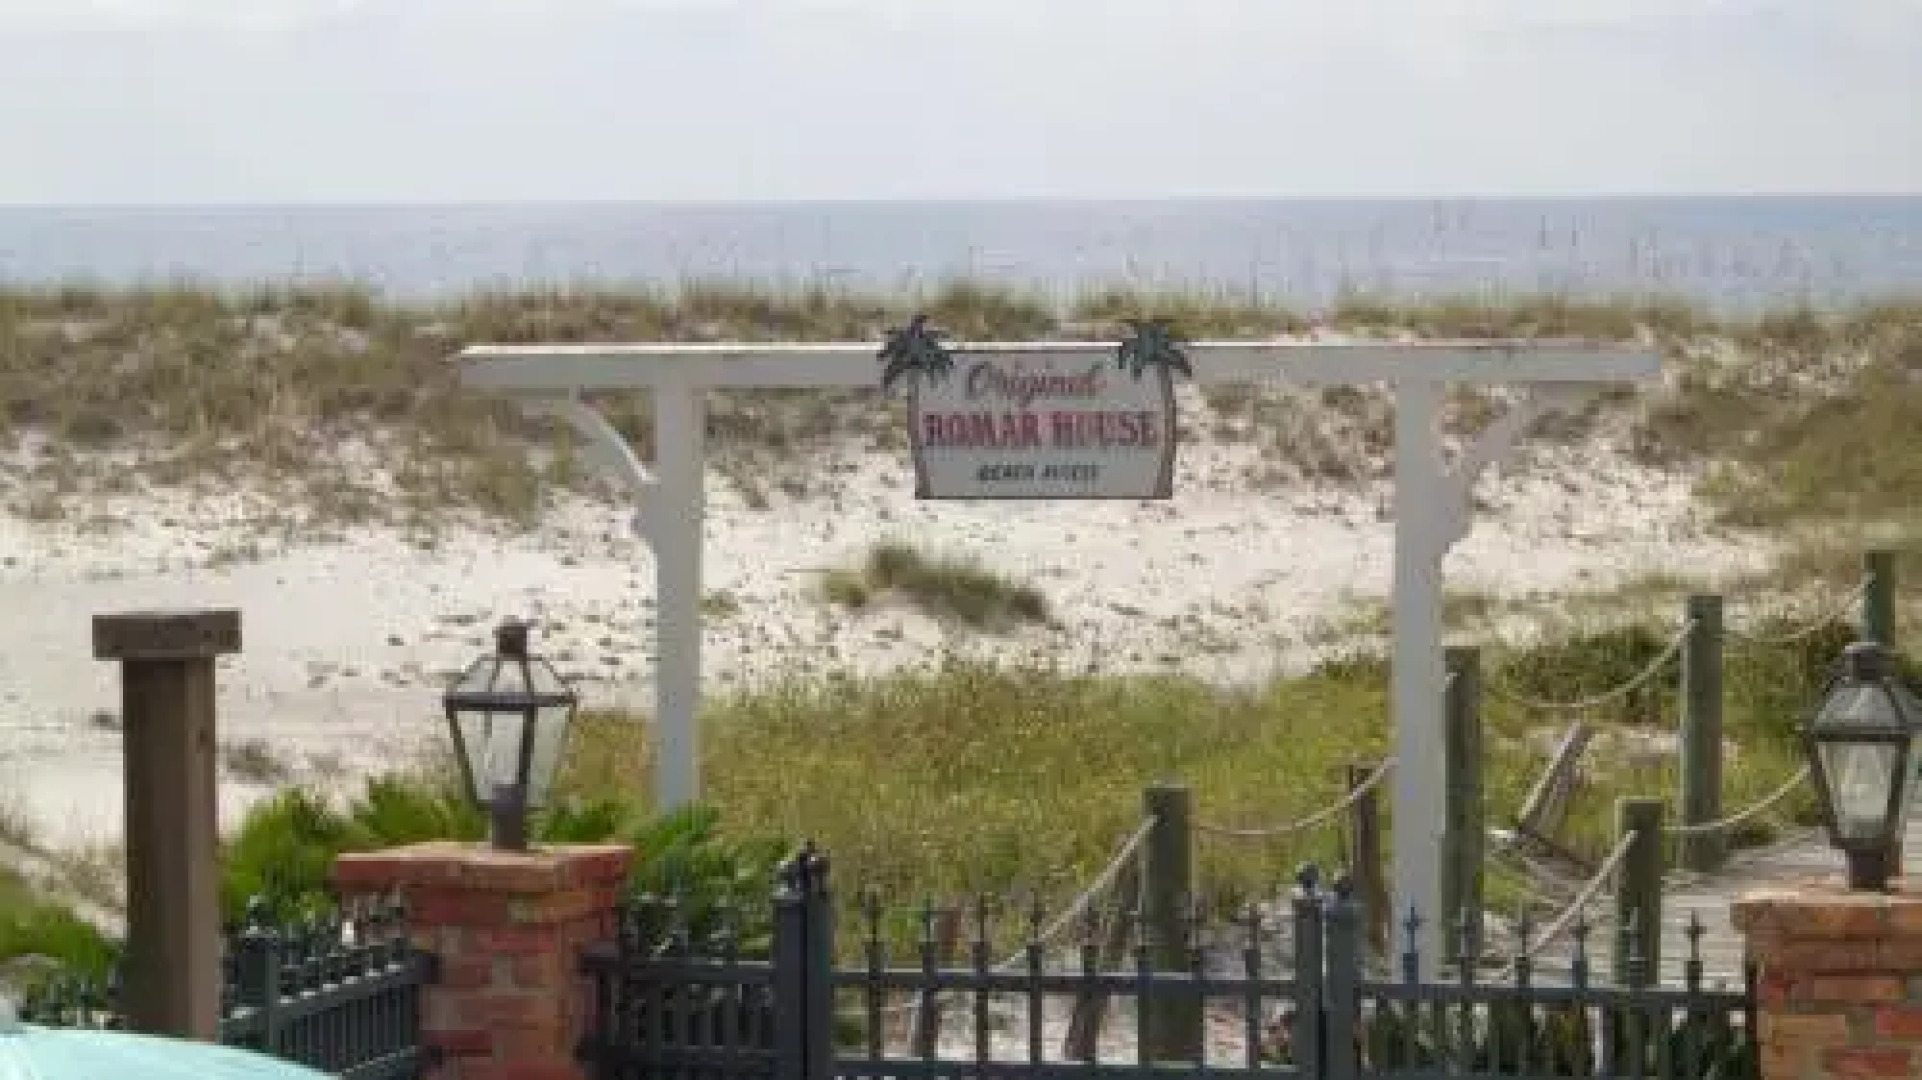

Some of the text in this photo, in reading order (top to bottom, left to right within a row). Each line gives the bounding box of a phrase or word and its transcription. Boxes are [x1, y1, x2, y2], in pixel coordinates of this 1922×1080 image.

[966, 359, 1107, 407] Original
[923, 411, 1160, 446] ROMAR HOUSE
